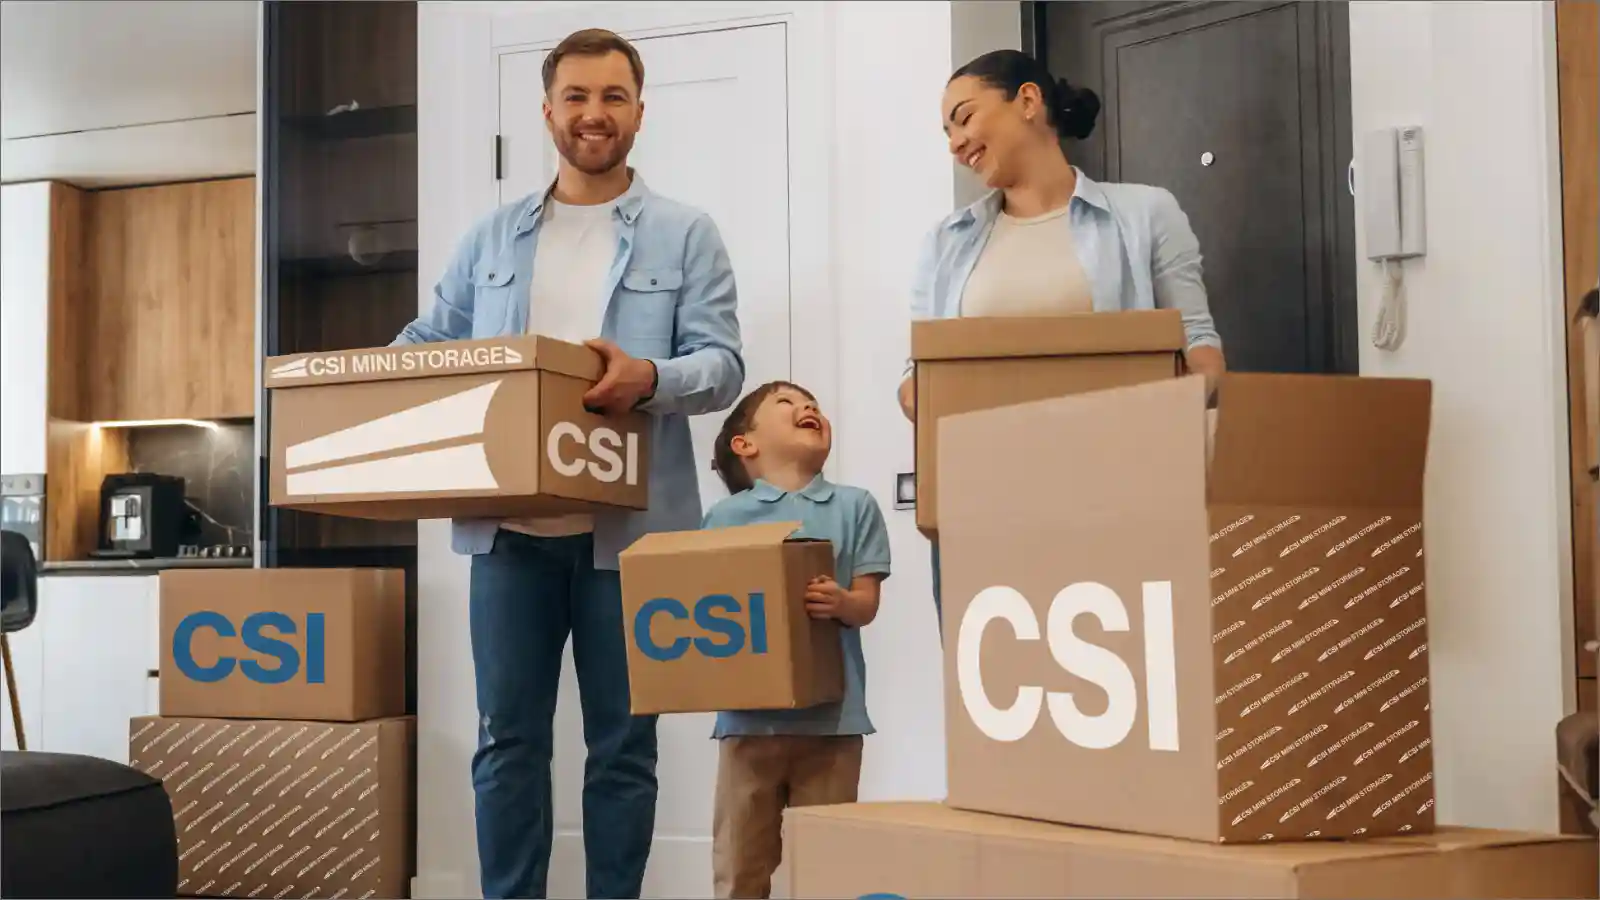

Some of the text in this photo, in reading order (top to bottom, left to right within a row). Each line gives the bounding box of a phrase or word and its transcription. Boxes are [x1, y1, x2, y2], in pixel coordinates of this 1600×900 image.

[309, 347, 504, 376] CSI MINI STORAGE
[547, 421, 638, 485] CSI
[172, 611, 325, 685] CSI
[634, 593, 768, 661] CSI
[957, 580, 1180, 752] CSI
